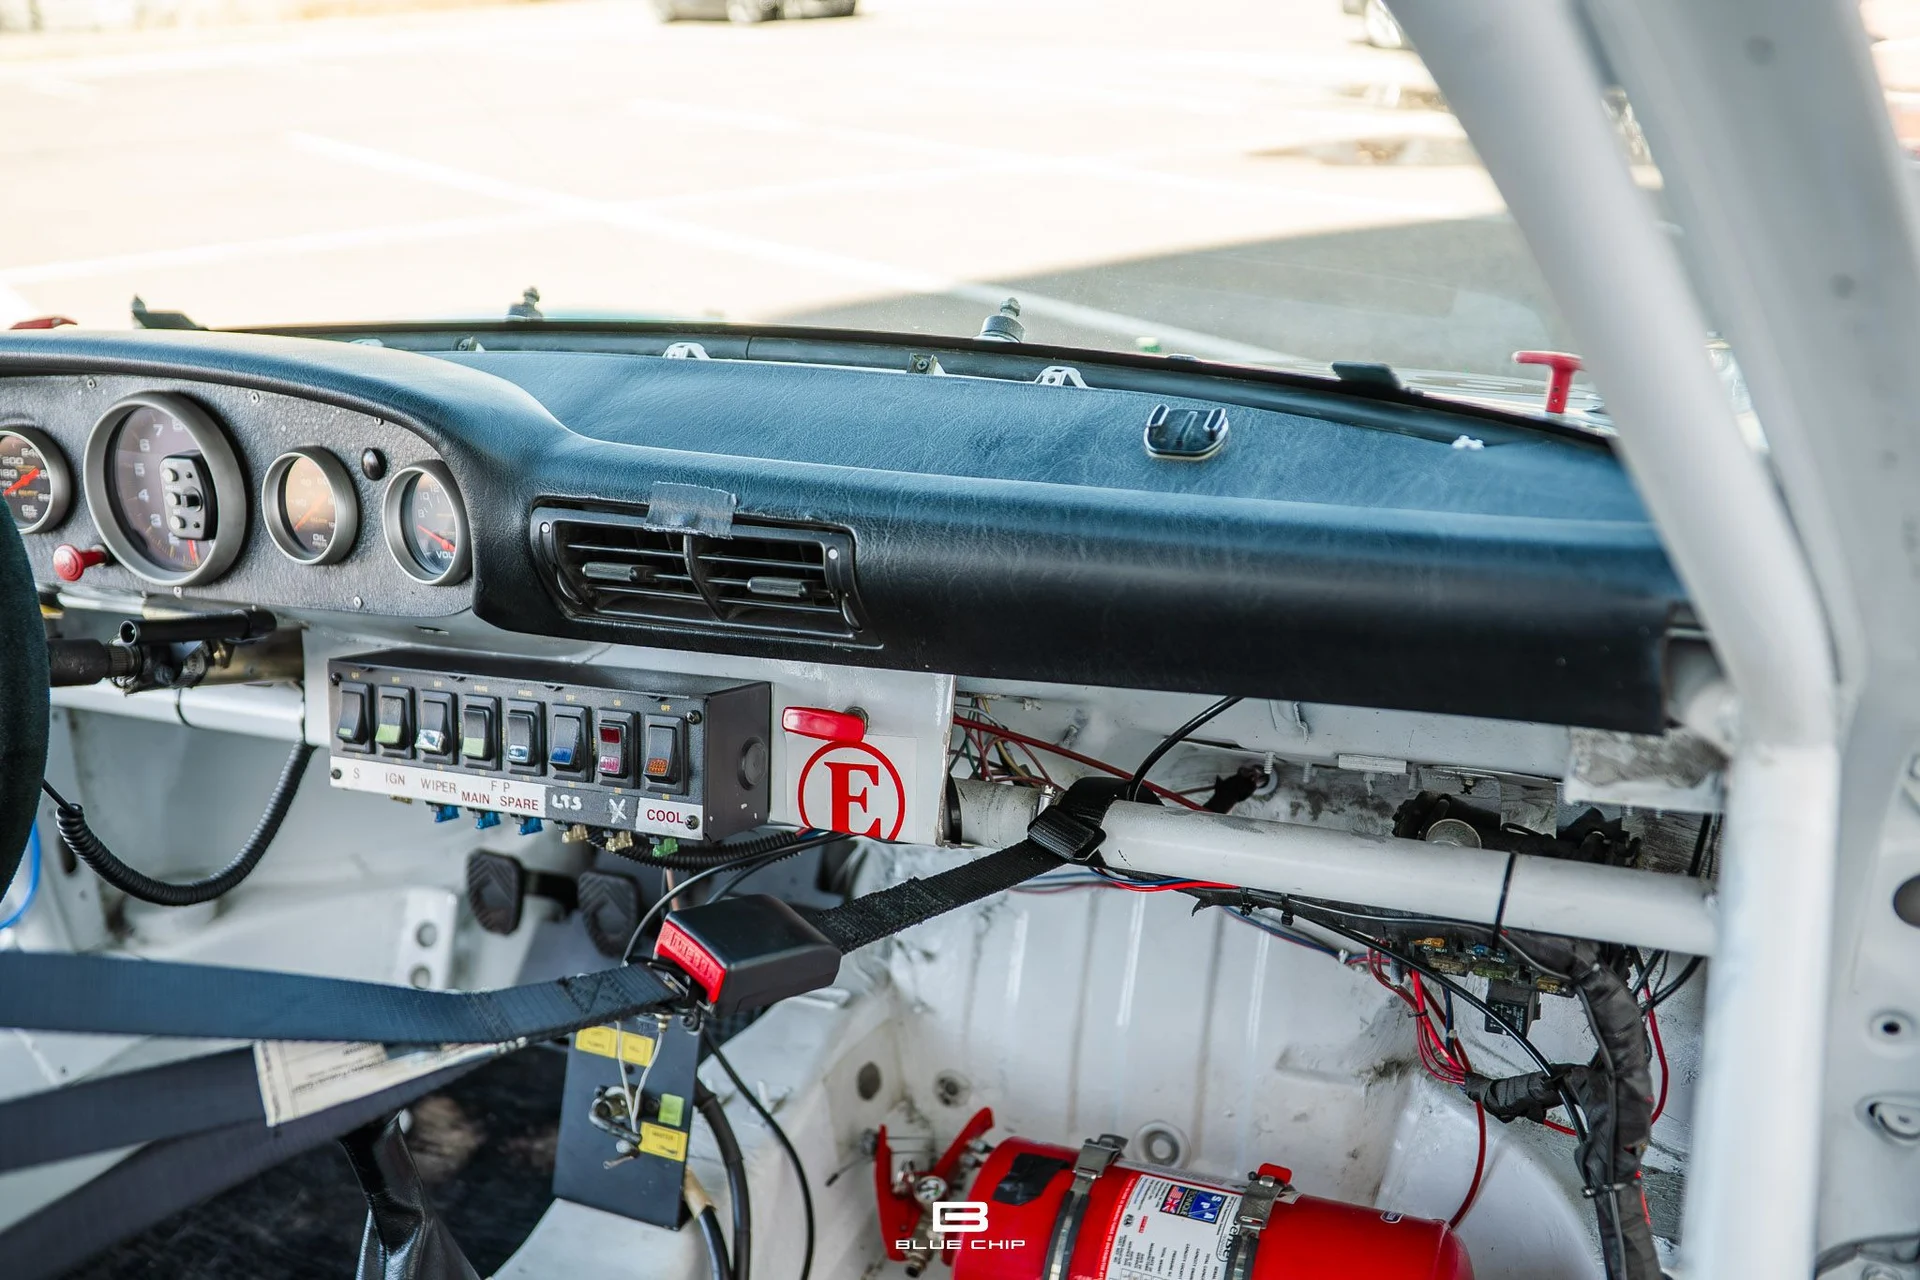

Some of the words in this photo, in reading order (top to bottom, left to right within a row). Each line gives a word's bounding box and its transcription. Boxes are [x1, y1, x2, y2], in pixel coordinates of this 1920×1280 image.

[153, 424, 164, 436] 7
[139, 438, 150, 451] 6
[3, 457, 24, 465] 200
[134, 463, 145, 477] 5
[429, 484, 440, 493] 12
[138, 489, 149, 502] 4
[419, 492, 430, 500] 10
[22, 504, 37, 512] OIL
[150, 514, 162, 528] 3
[312, 534, 327, 542] OIL
[353, 769, 361, 779] S
[385, 772, 406, 786] IGN
[421, 778, 457, 794] WIPER
[491, 780, 498, 792] F
[503, 781, 511, 792] P
[461, 791, 491, 805] MAIN
[500, 796, 539, 811] SPARE
[552, 794, 582, 811] LTS
[823, 761, 882, 839] E
[1201, 1195, 1222, 1220] SPA
